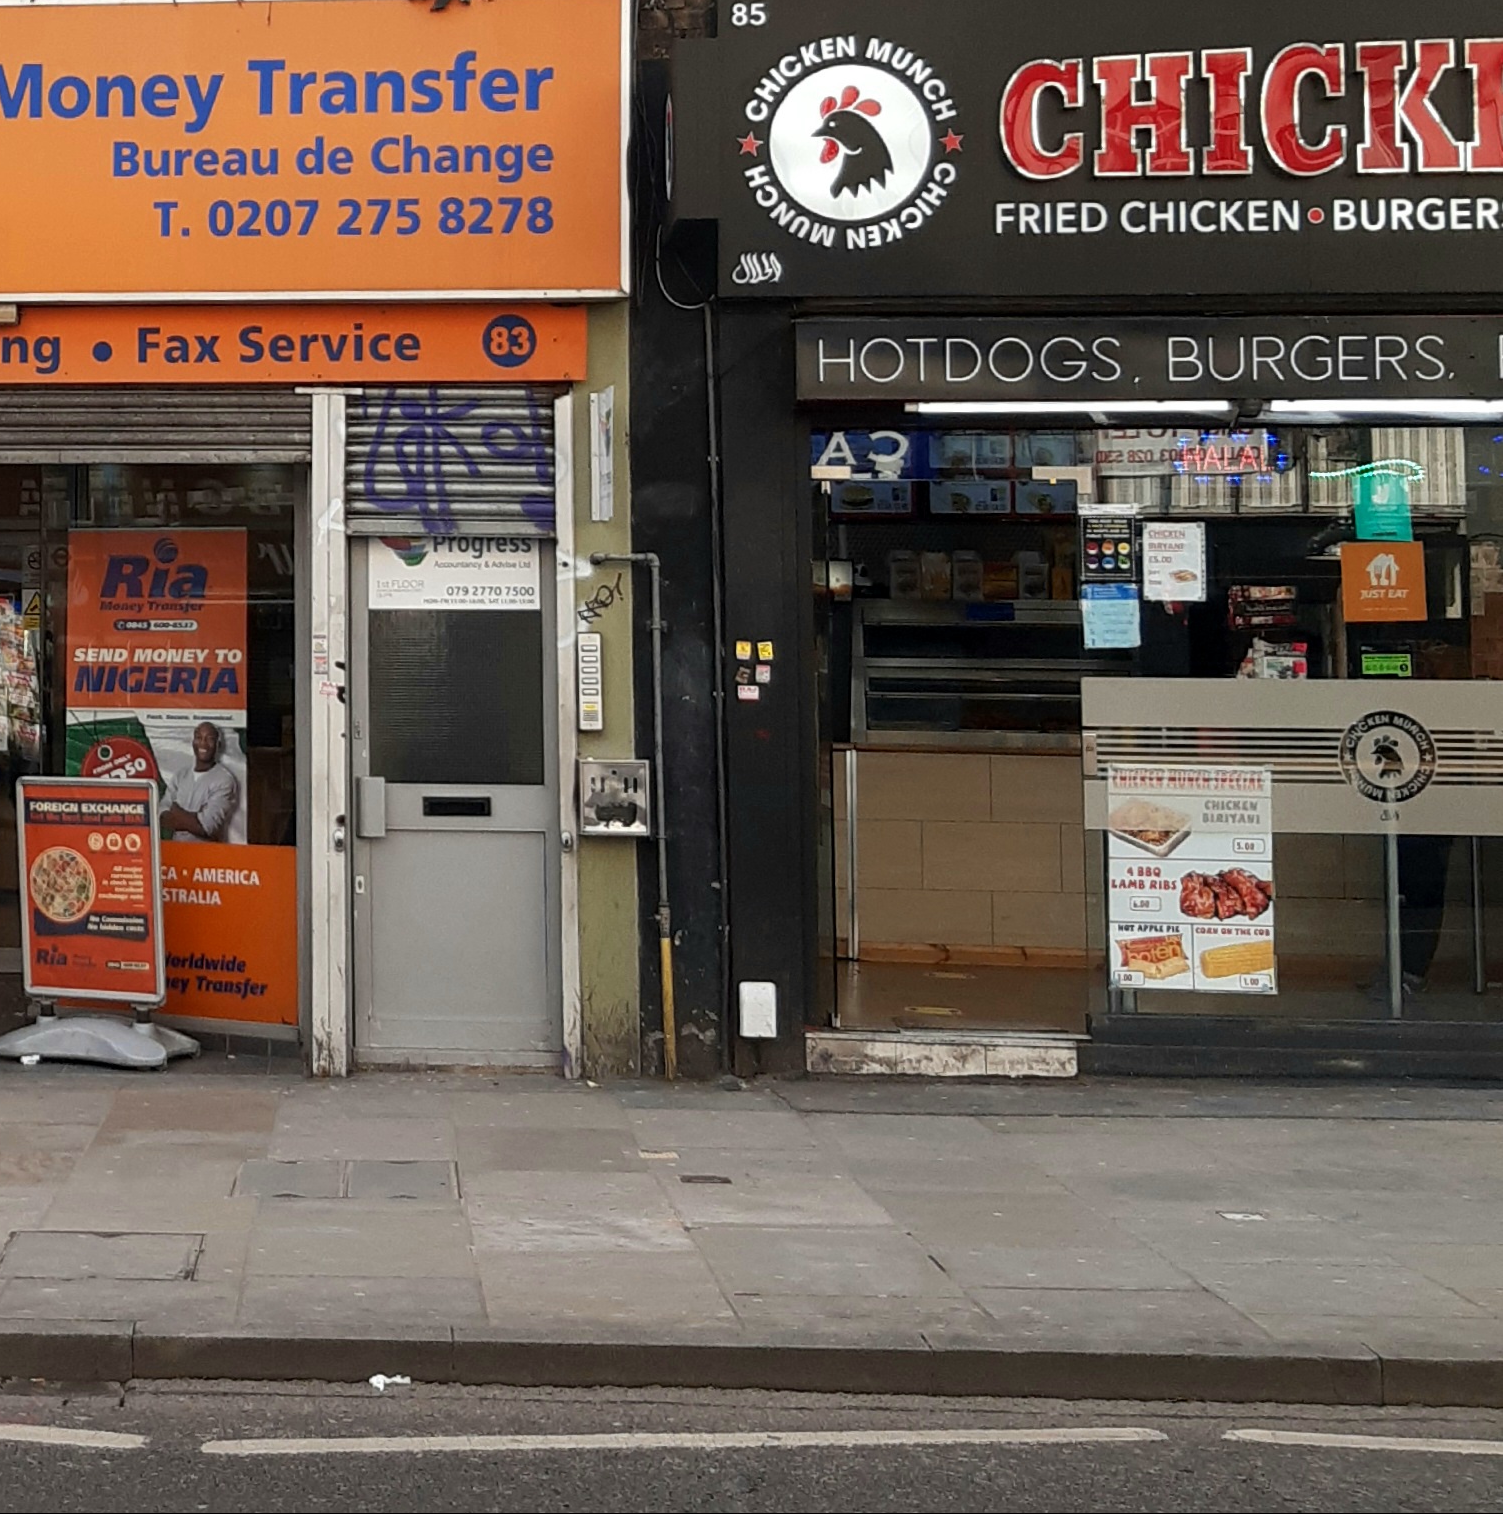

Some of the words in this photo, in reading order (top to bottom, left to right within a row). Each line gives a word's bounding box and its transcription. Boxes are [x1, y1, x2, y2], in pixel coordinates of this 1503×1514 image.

[731, 3, 766, 26] 85
[248, 50, 554, 116] Transfer
[746, 36, 856, 122] CHICKEN
[865, 38, 957, 121] MUNCH
[113, 141, 278, 176] Bureau
[296, 138, 353, 175] de
[370, 135, 554, 183] Change
[153, 201, 191, 237] T.
[207, 199, 319, 237] 0207
[337, 198, 420, 235] 275
[438, 196, 554, 235] 8278
[744, 164, 836, 248] MUNCH
[846, 162, 957, 250] CHICKEN
[995, 202, 1108, 234] FRIED
[1119, 200, 1299, 233] CHICKEN
[1333, 197, 1503, 231] BURGER
[138, 327, 220, 364] Fax
[239, 323, 420, 364] Service
[490, 326, 531, 356] 83
[1181, 444, 1267, 471] HALAL
[100, 537, 209, 599] Ria
[434, 560, 481, 569] Accountancy
[491, 560, 516, 569] Advise
[518, 561, 531, 569] Ltd
[391, 580, 424, 588] FLOOR
[446, 587, 469, 596] 079
[472, 587, 502, 596] 2770
[505, 586, 535, 596] 7500
[1360, 589, 1385, 600] JUST
[1388, 589, 1410, 599] EAT
[100, 601, 144, 614] Money
[148, 601, 204, 613] Transfer
[74, 648, 128, 662] SEND
[133, 648, 209, 663] MONEY
[215, 649, 242, 663] TO
[74, 665, 239, 694] NIGERIA
[1346, 715, 1390, 748] CHICKEN
[1393, 715, 1430, 750] MUNCH
[29, 801, 79, 813] FOREIGN
[81, 803, 145, 815] EXCHANGE
[1204, 800, 1258, 811] CHICKEN
[1202, 813, 1260, 824] BIRIYANI
[193, 868, 260, 886] AMERICA
[1126, 867, 1134, 877] 4
[1137, 866, 1161, 877] BBQ
[1111, 880, 1145, 890] LAMB
[1149, 880, 1177, 890] RIBS
[162, 888, 222, 905] STRALIA
[1118, 924, 1135, 932] HOT
[1166, 925, 1180, 933] PIE
[1195, 927, 1218, 935] CORN
[1221, 927, 1232, 935] ON
[1253, 928, 1270, 936] COB
[36, 944, 67, 965] Ria
[196, 976, 268, 999] Transfer
